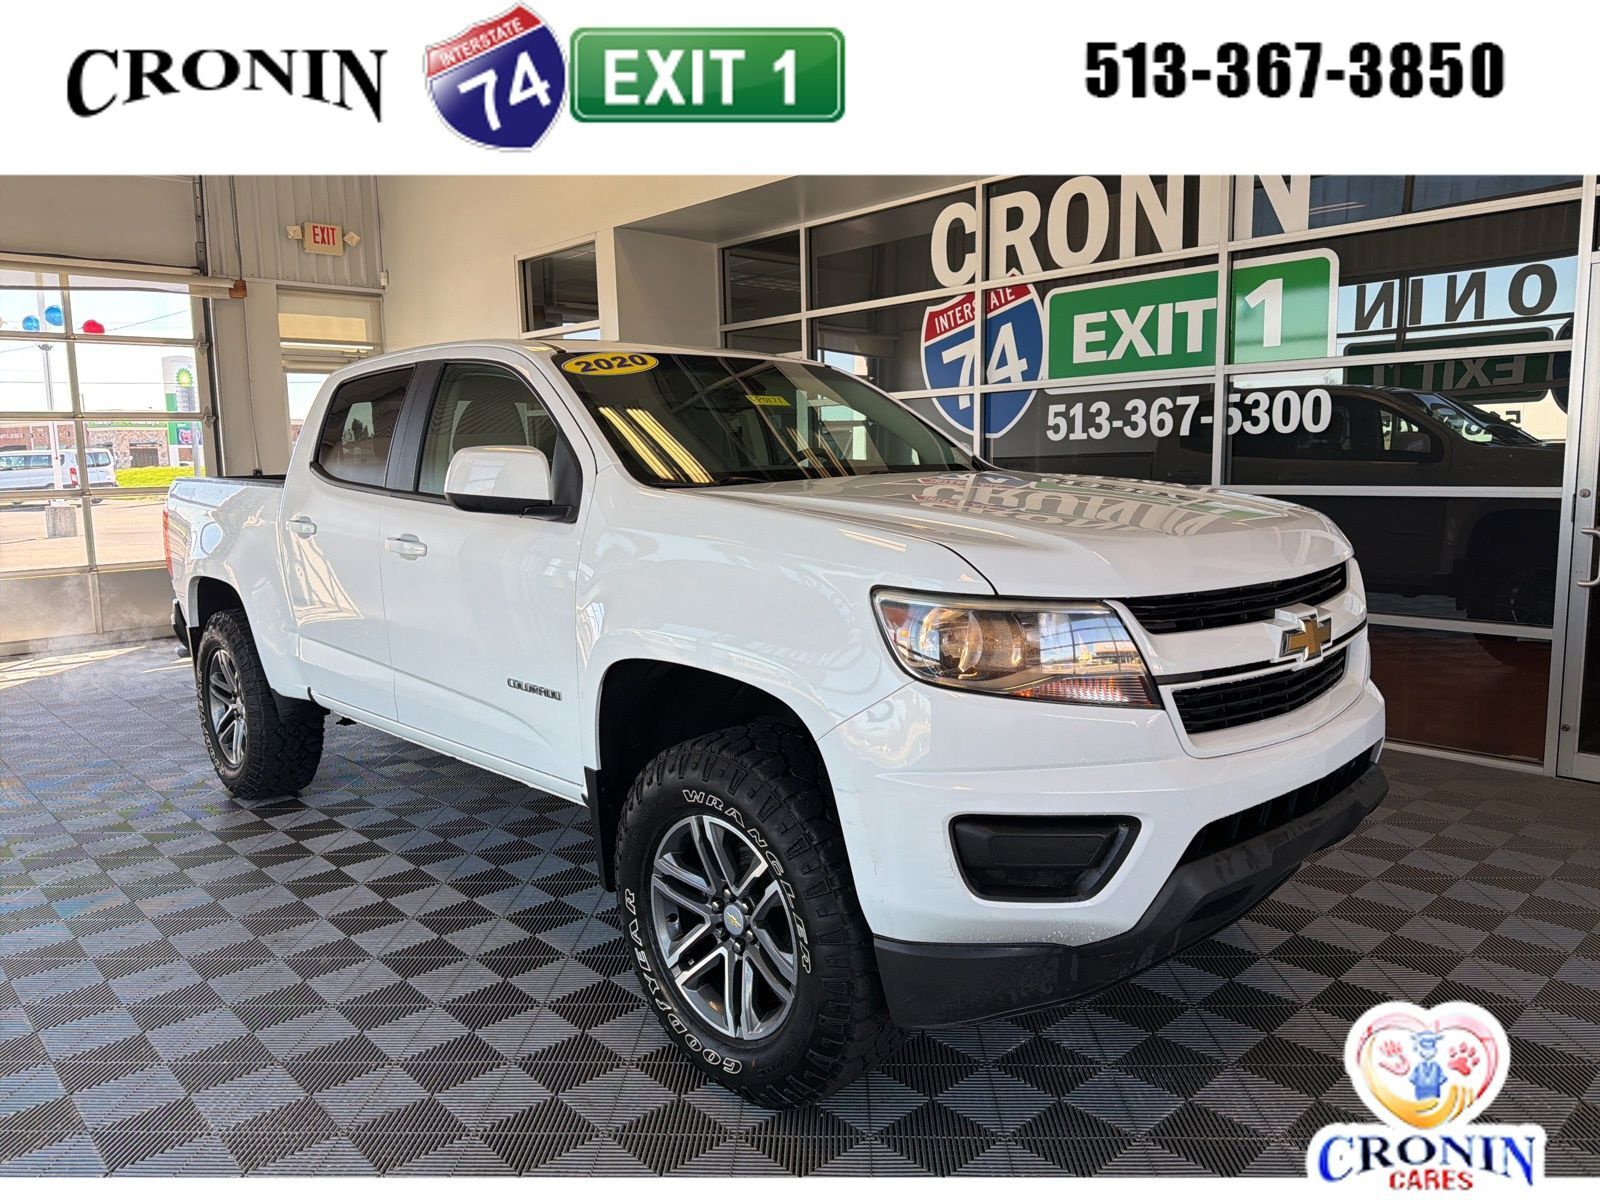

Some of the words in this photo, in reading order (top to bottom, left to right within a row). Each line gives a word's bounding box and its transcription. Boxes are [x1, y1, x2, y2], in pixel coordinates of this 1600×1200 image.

[312, 225, 336, 246] EXIT
[931, 175, 1309, 288] CRONIN
[934, 287, 1016, 335] INTERATE
[1072, 297, 1217, 364] EXIT
[1244, 278, 1283, 347] 1
[574, 354, 648, 372] 2020
[941, 321, 1028, 410] 74
[1046, 388, 1332, 441] 513-367-5300
[507, 678, 562, 701] COLORADO
[683, 789, 812, 974] WRANGLER
[625, 888, 742, 1074] GOODYEAR
